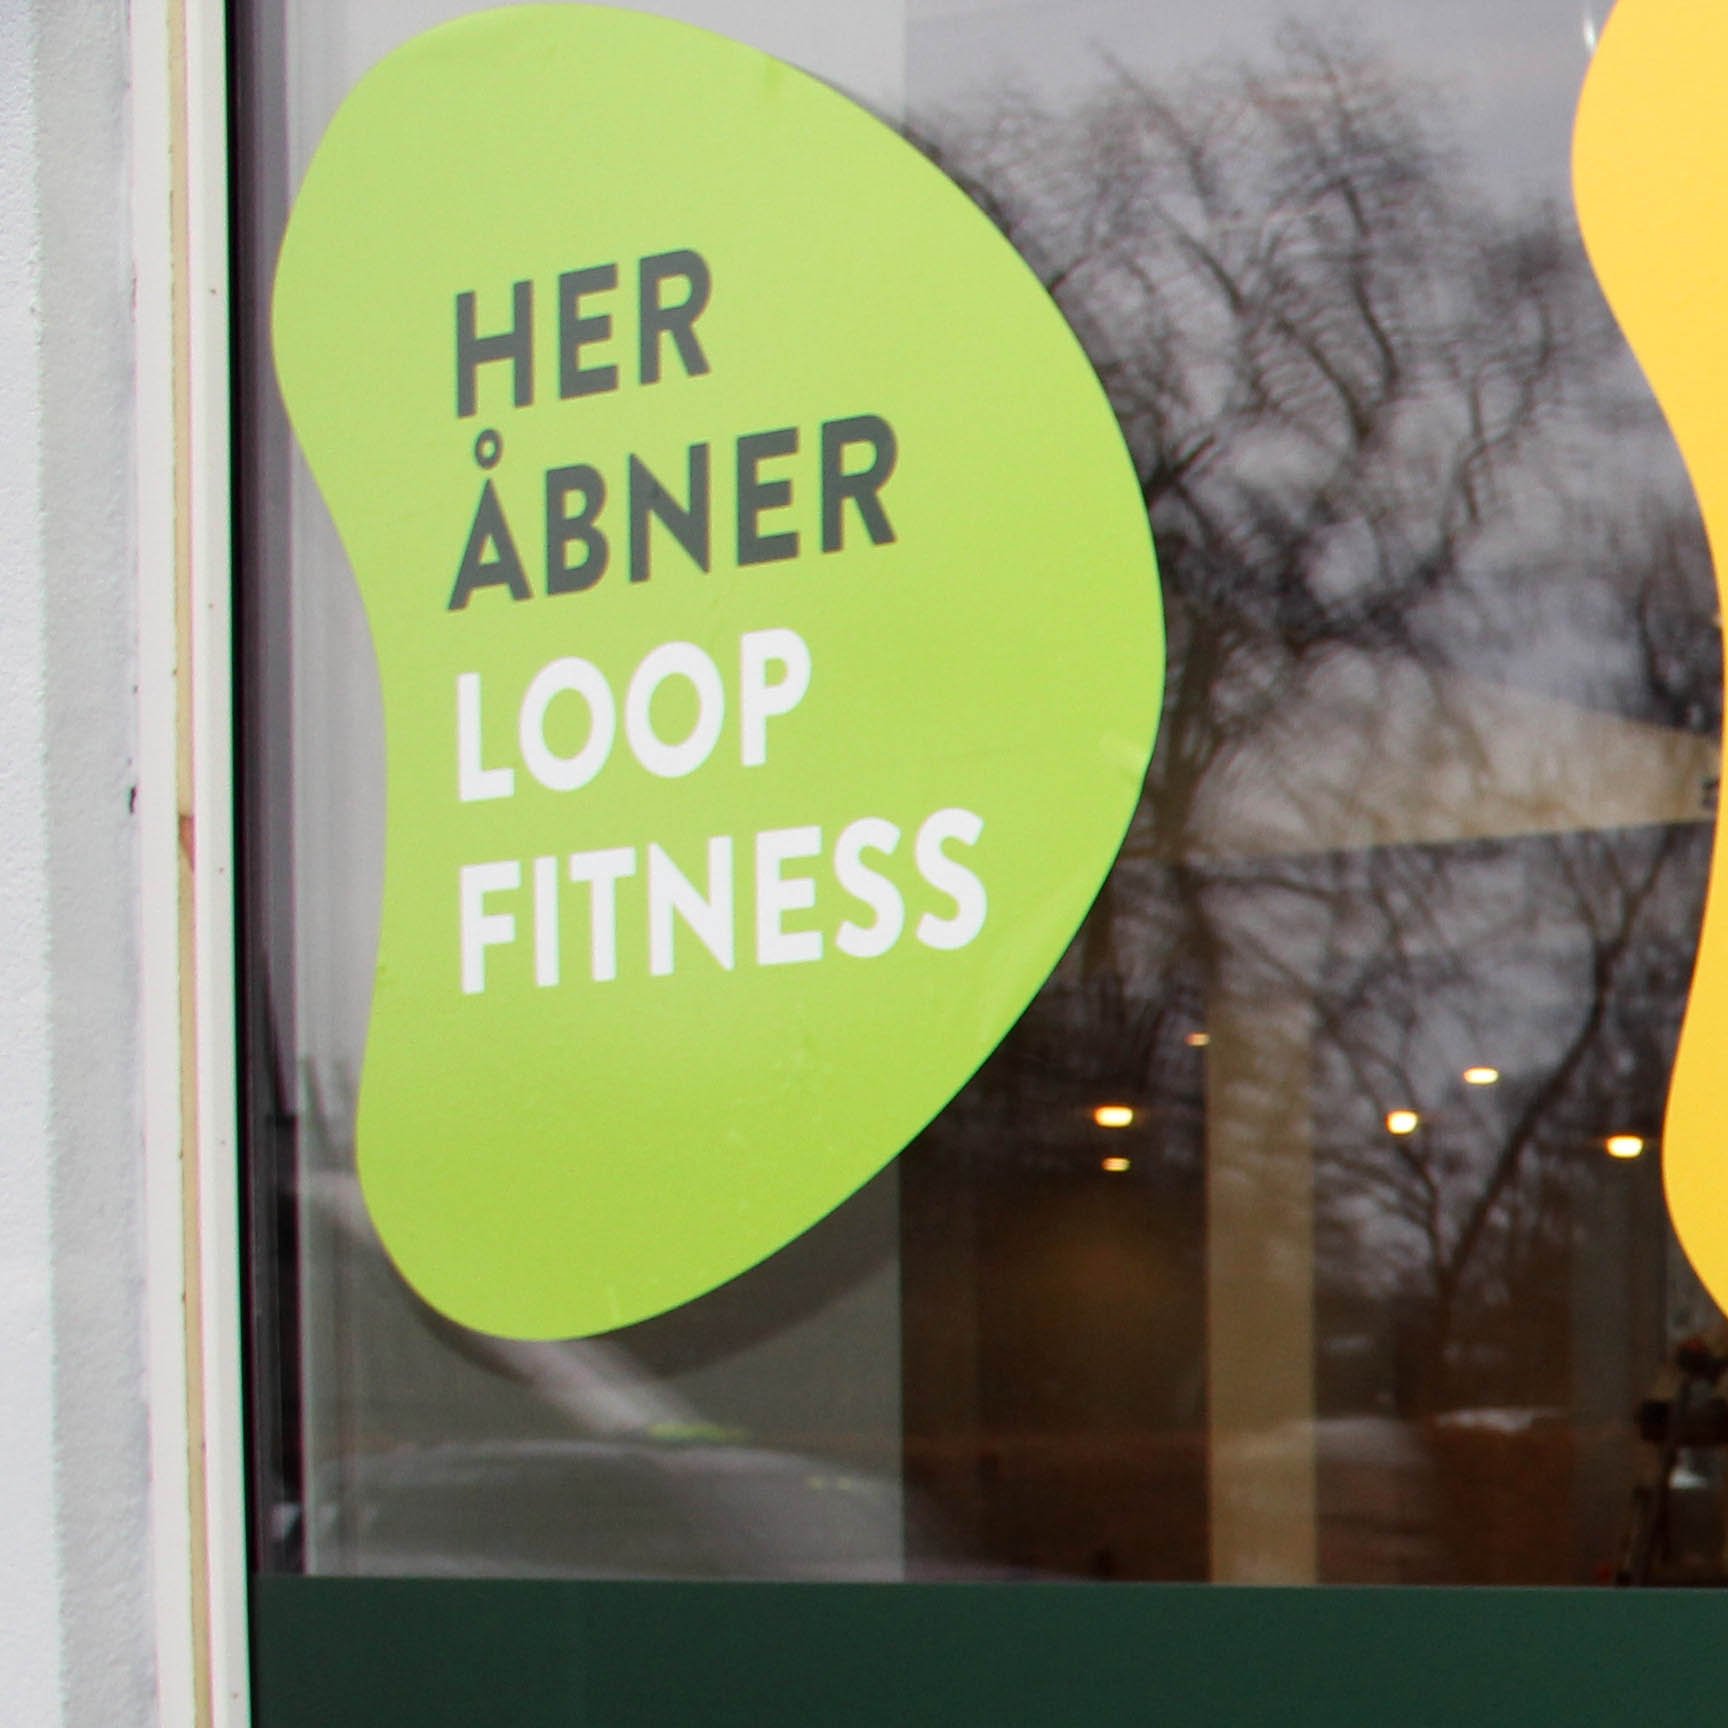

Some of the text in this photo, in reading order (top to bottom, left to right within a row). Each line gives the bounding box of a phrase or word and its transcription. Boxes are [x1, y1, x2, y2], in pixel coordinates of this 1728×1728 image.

[455, 248, 712, 419] HER
[446, 413, 898, 614] ÅBNER
[455, 626, 813, 804] LOOP
[458, 806, 989, 996] FITNESS
